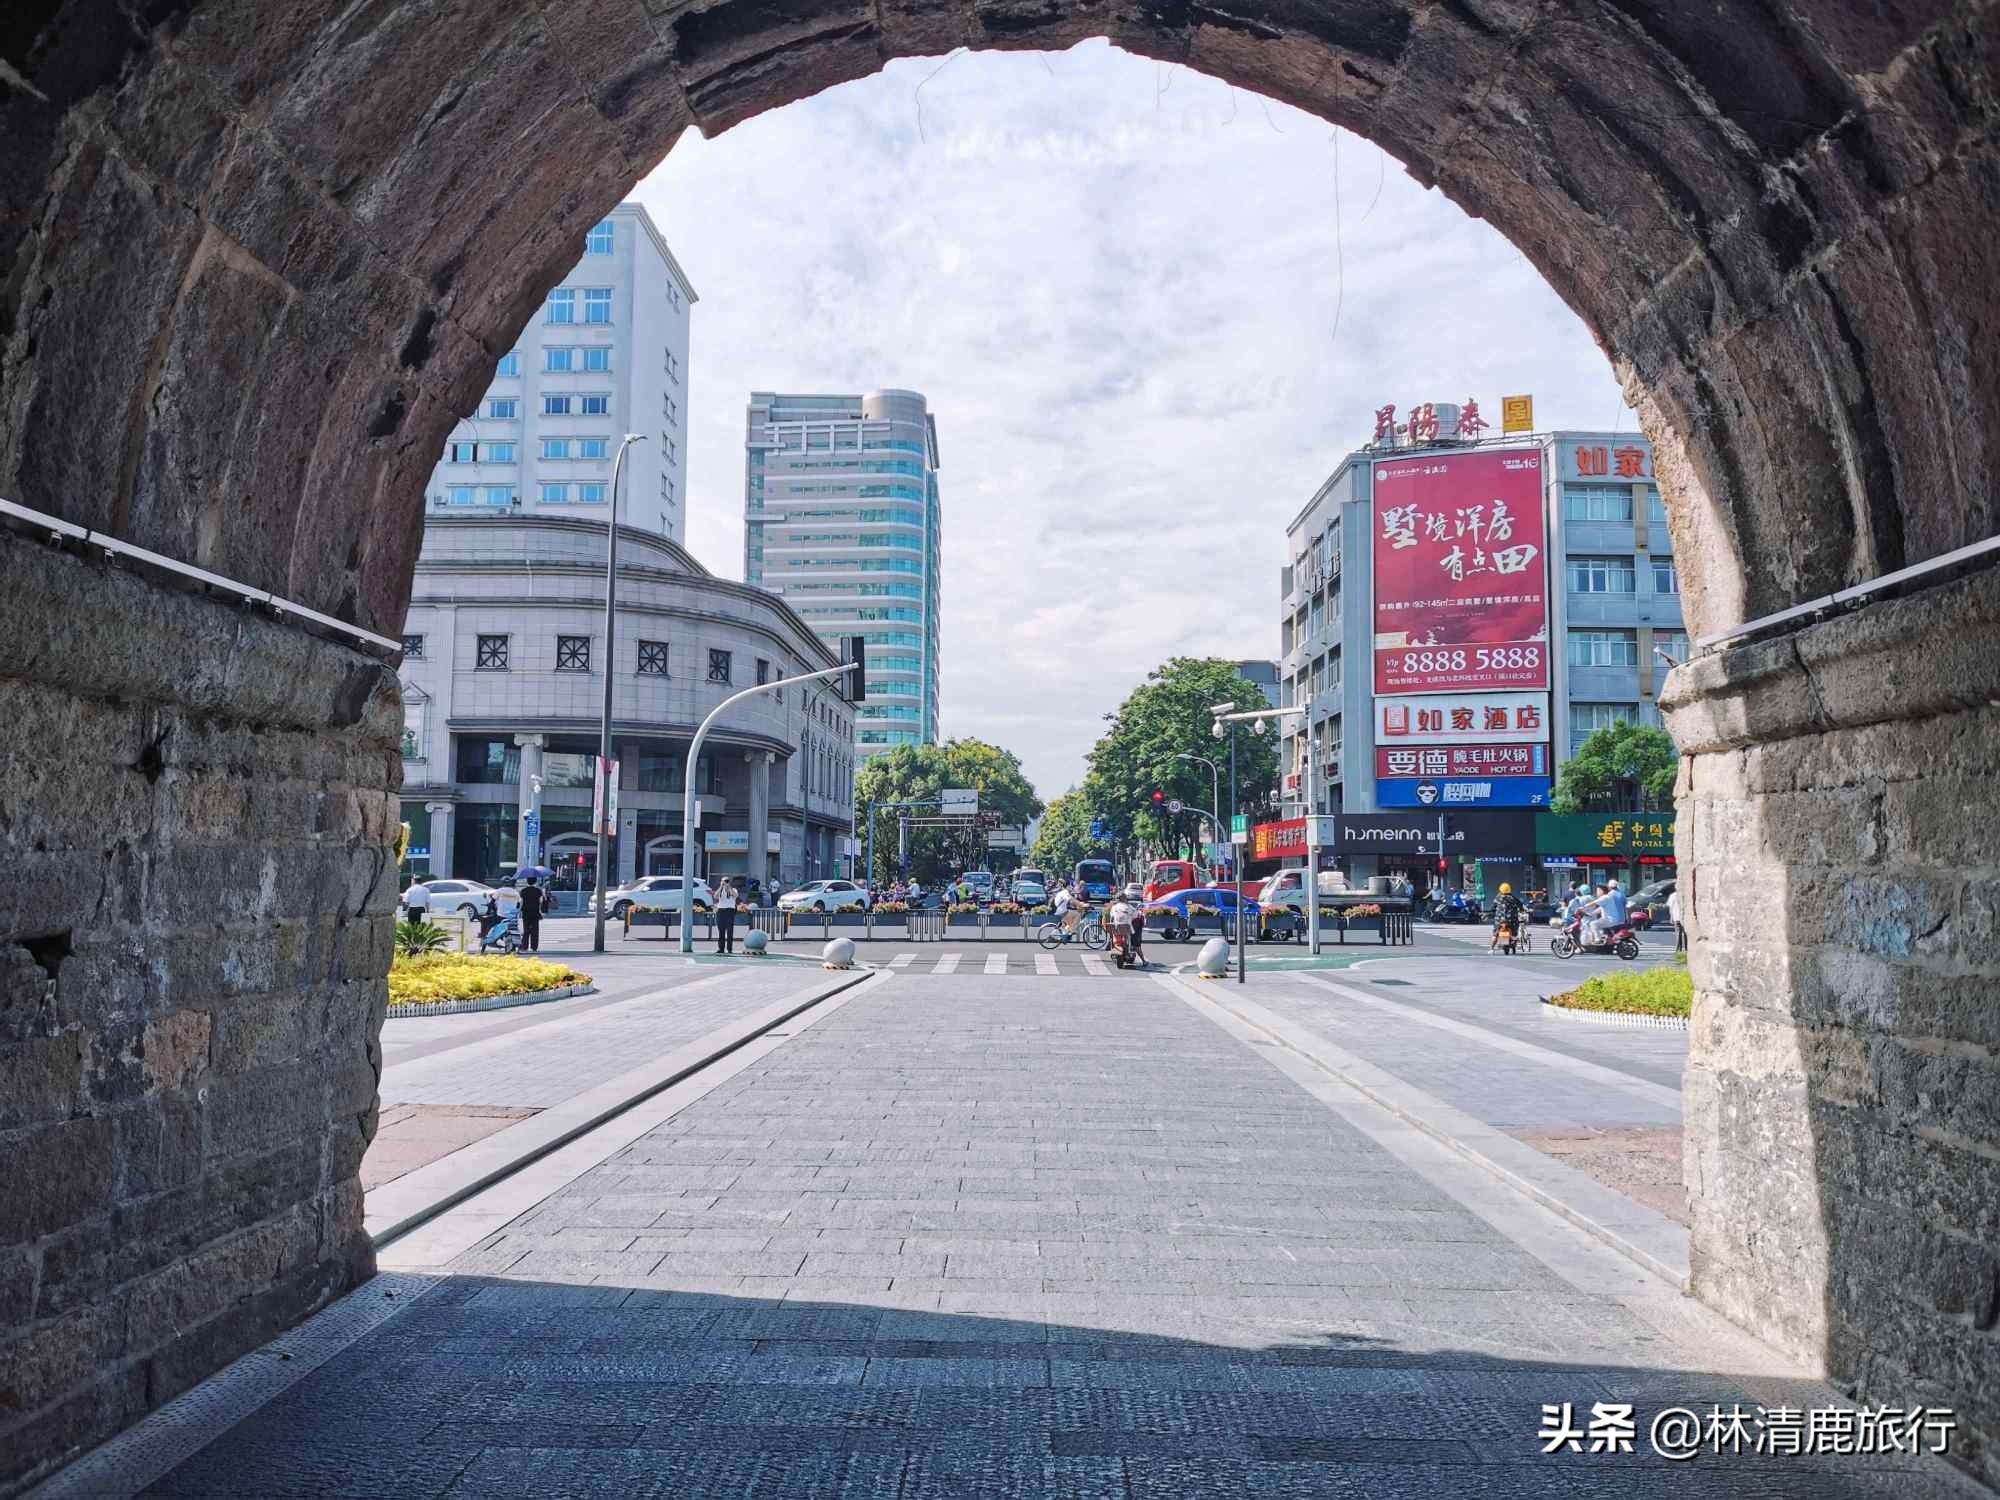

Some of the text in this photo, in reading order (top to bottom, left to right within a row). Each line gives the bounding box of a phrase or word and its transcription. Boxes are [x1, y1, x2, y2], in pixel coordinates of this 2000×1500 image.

[1575, 444, 1655, 478] 如家
[1381, 500, 1515, 550] 墅境洋房
[1440, 544, 1538, 581] 有点田
[1403, 650, 1466, 674] 8888
[1475, 647, 1540, 671] 5888
[1417, 705, 1540, 732] 如家酒店
[1387, 750, 1448, 775] 要德
[1490, 766, 1507, 774] HOT
[1345, 826, 1421, 841] homeinn
